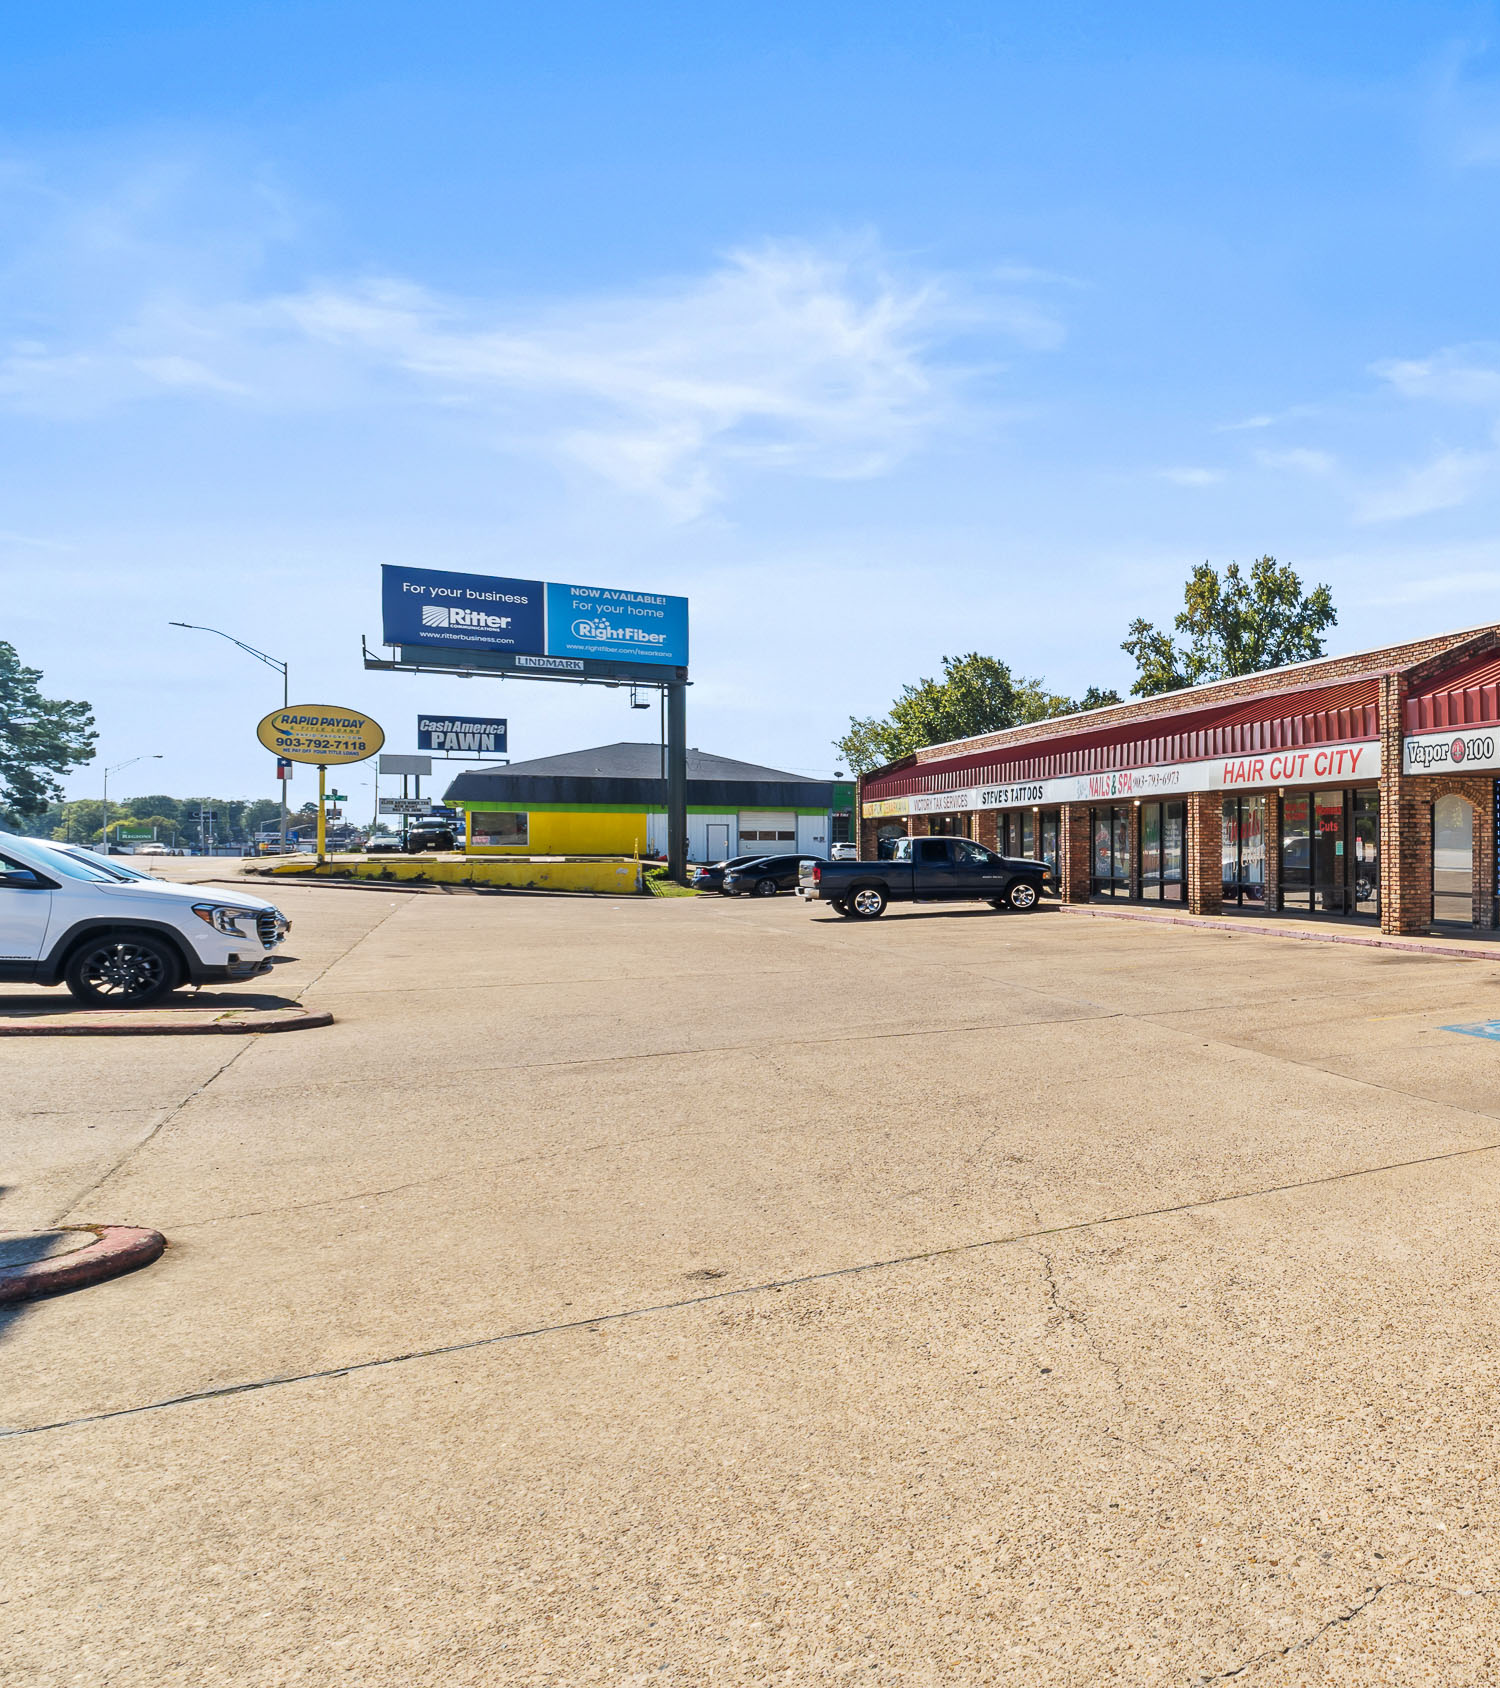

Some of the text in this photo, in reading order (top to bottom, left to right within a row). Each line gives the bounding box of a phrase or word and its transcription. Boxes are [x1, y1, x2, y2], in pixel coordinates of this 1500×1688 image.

[403, 582, 529, 605] For your business
[570, 587, 667, 606] NOW AVAILABLE!
[449, 607, 512, 629] Ritter
[573, 600, 665, 618] For your home
[419, 631, 515, 644] www.ritterbusiness.com
[579, 621, 667, 643] RightFiber
[517, 657, 582, 669] LINDMARK
[281, 714, 366, 729] RAPID PAYDAY
[276, 737, 367, 751] 903-792-7118
[431, 732, 495, 751] PAWN
[1407, 741, 1450, 767] Vapor
[1466, 736, 1495, 761] 100
[1223, 747, 1365, 784] HAIR CUT CITY
[982, 785, 1044, 804] STEVE'S TATTOOS
[1089, 775, 1111, 798] NAILS
[1111, 774, 1117, 796] &
[1117, 773, 1133, 794] SPA
[943, 794, 969, 810] SERVICES
[1319, 821, 1339, 832] Cuts
